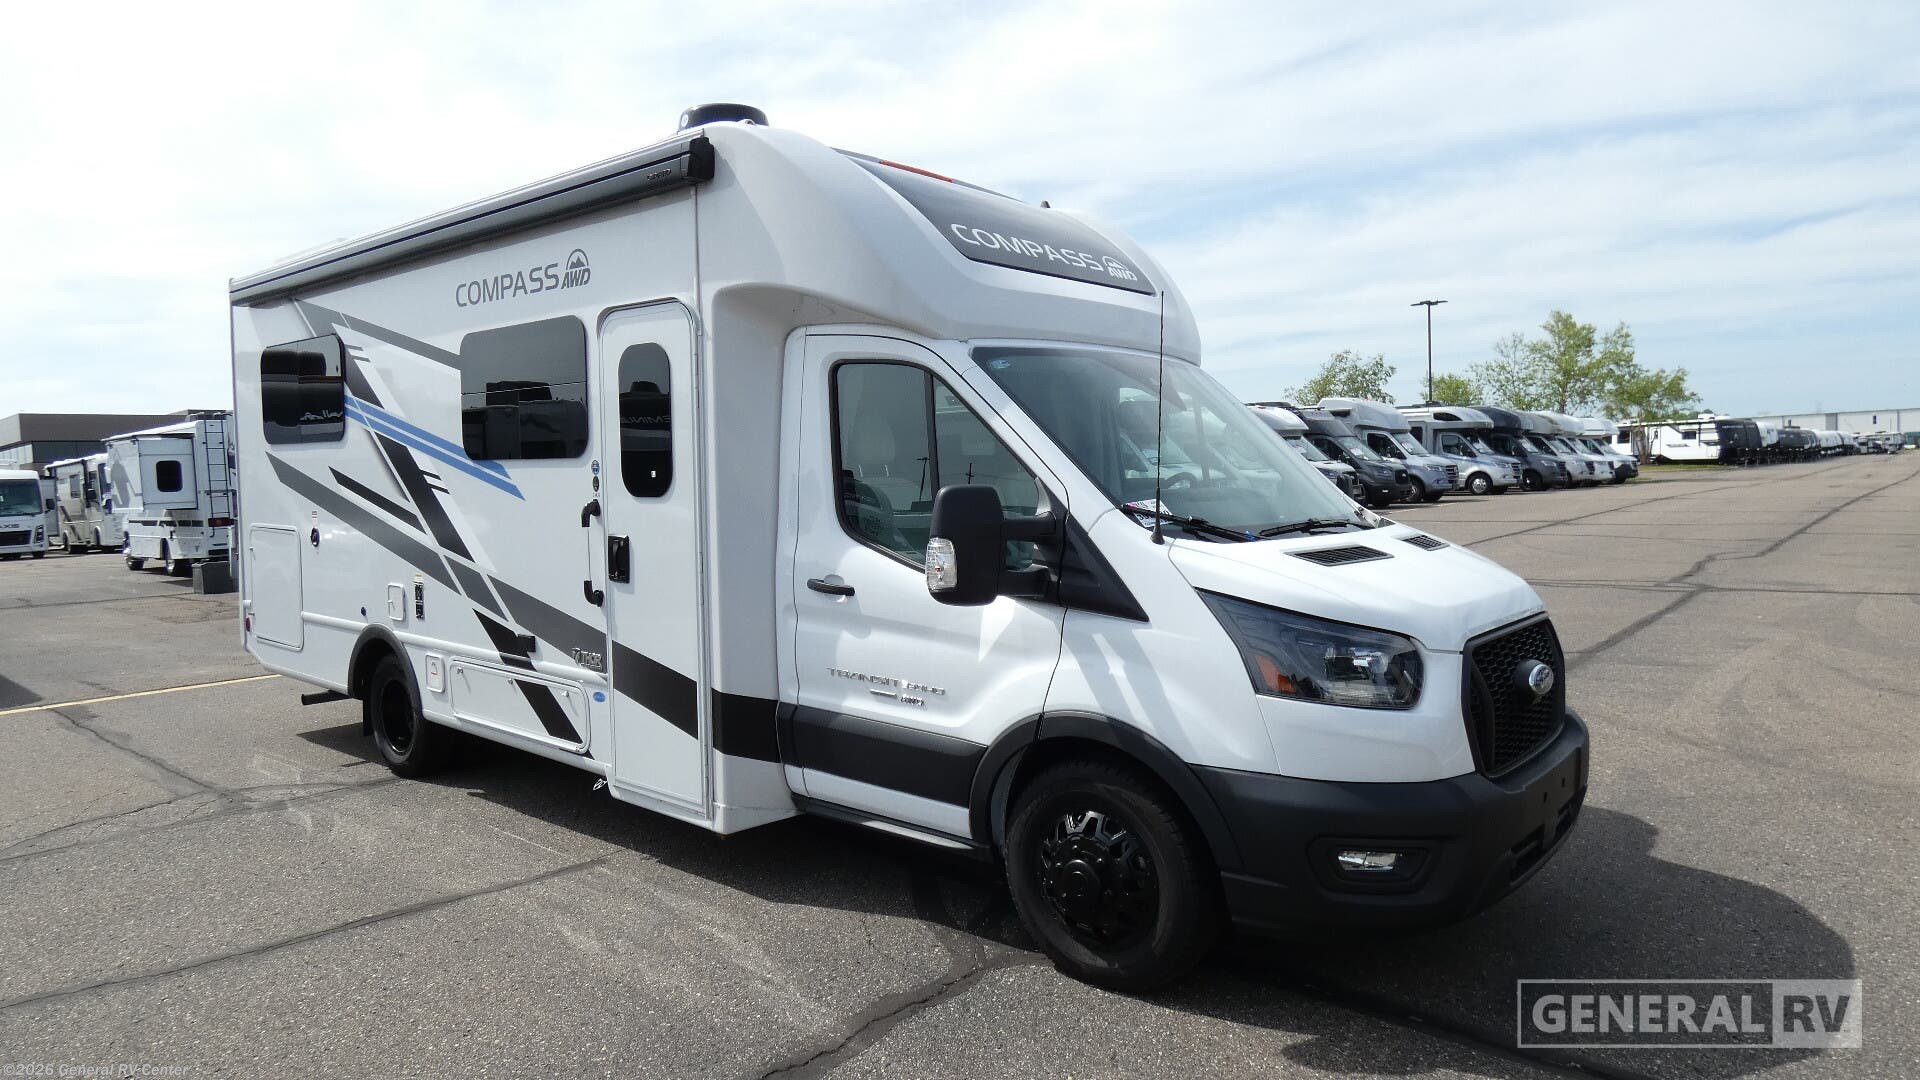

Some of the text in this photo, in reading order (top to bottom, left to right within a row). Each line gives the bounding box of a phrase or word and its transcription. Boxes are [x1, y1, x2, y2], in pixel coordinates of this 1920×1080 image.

[950, 223, 1104, 272] COMPASS
[455, 262, 560, 308] COMPASS
[561, 268, 591, 290] AWD
[1108, 266, 1138, 282] AWD
[826, 667, 900, 688] TRANSIT
